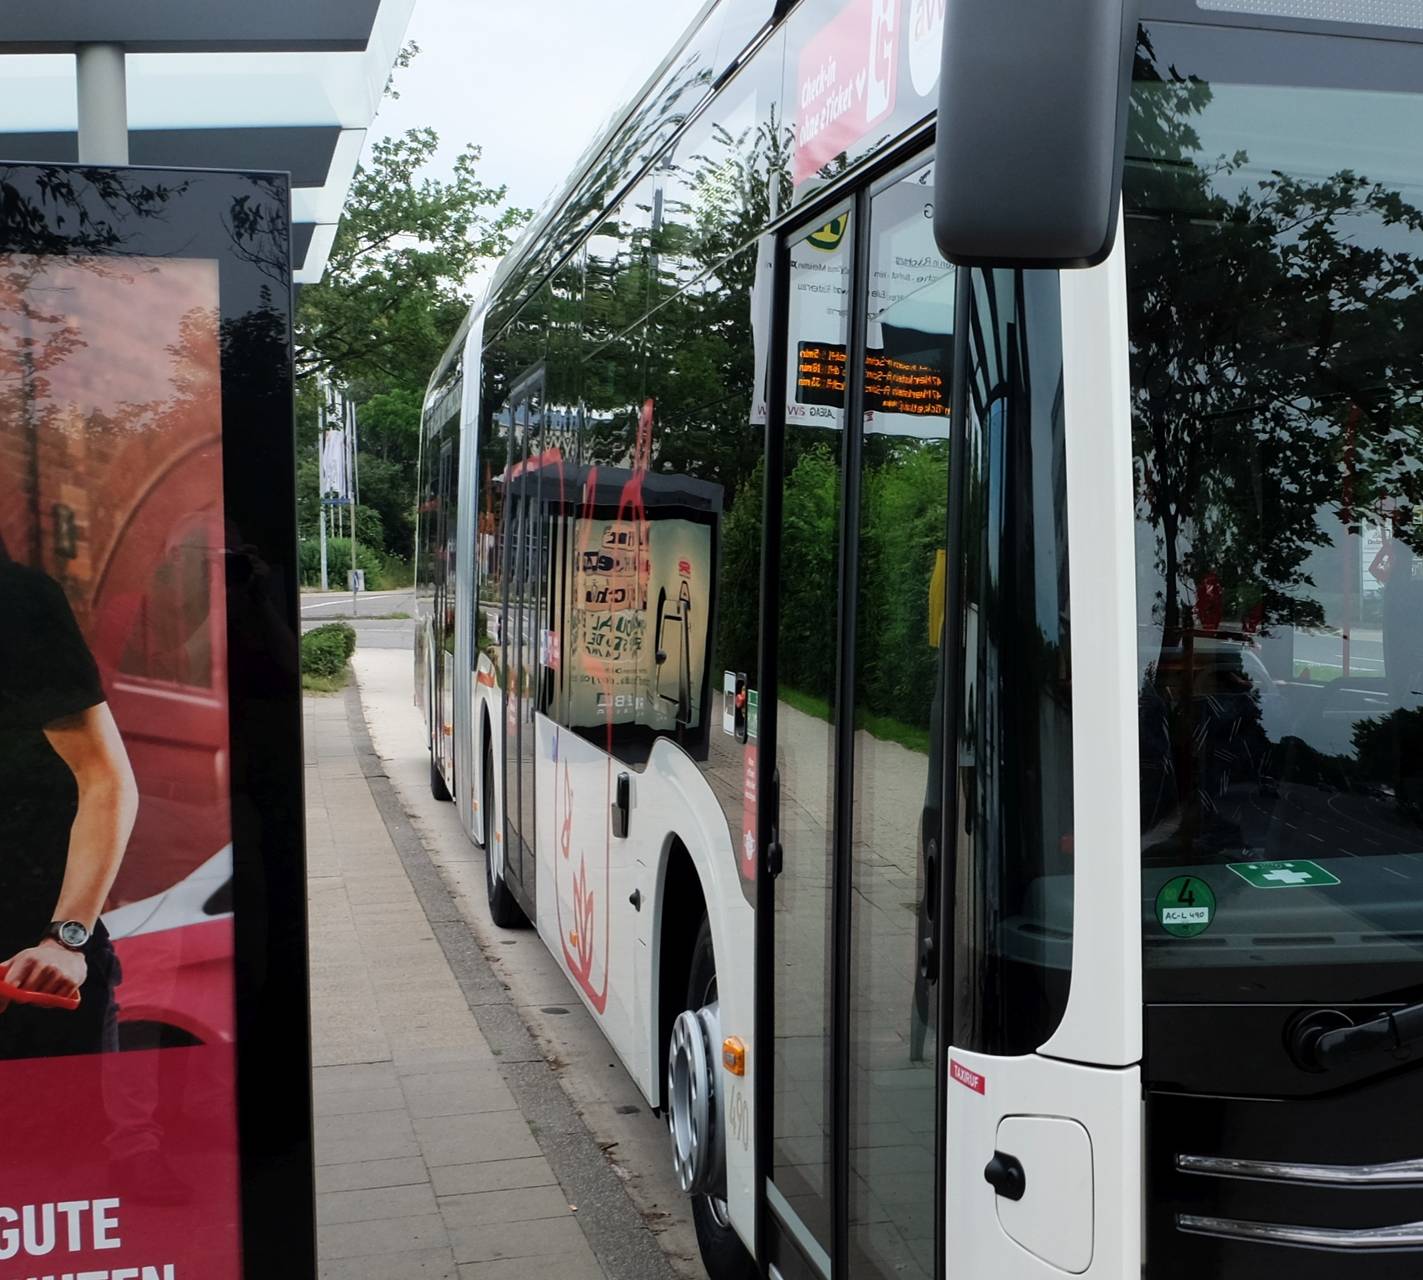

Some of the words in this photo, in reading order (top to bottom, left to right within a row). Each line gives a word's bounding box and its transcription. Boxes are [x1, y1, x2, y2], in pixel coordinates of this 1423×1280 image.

[801, 55, 836, 110] Check-in
[799, 113, 819, 148] ohne
[1178, 879, 1195, 906] 4
[0, 1197, 121, 1261] GUTE
